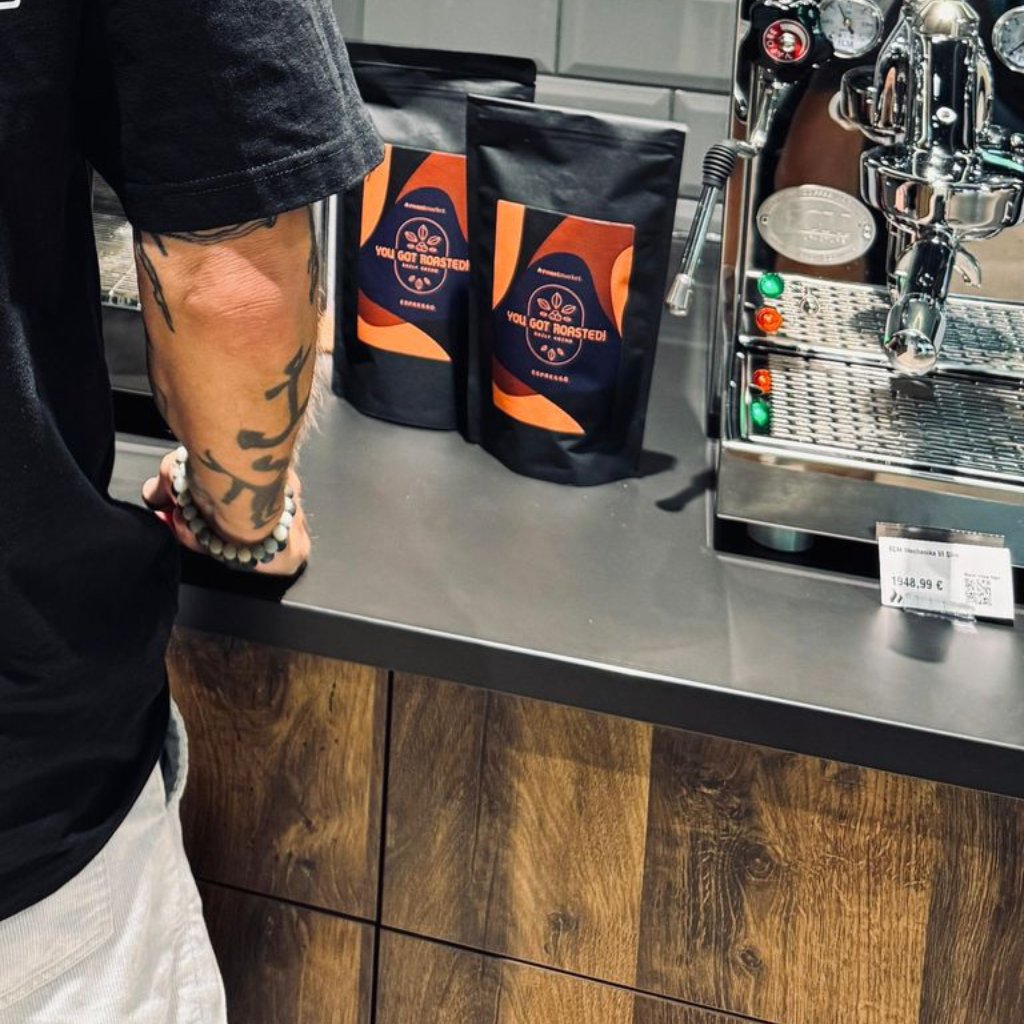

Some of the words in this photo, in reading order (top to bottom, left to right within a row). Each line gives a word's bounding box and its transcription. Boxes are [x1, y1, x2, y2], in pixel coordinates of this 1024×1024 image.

[375, 245, 395, 259] YOU
[397, 250, 417, 263] GOT
[420, 254, 470, 272] ROASTED!
[507, 310, 526, 326] YOU
[529, 318, 550, 332] GOT
[553, 323, 607, 342] ROASTED!
[936, 580, 943, 591] €
